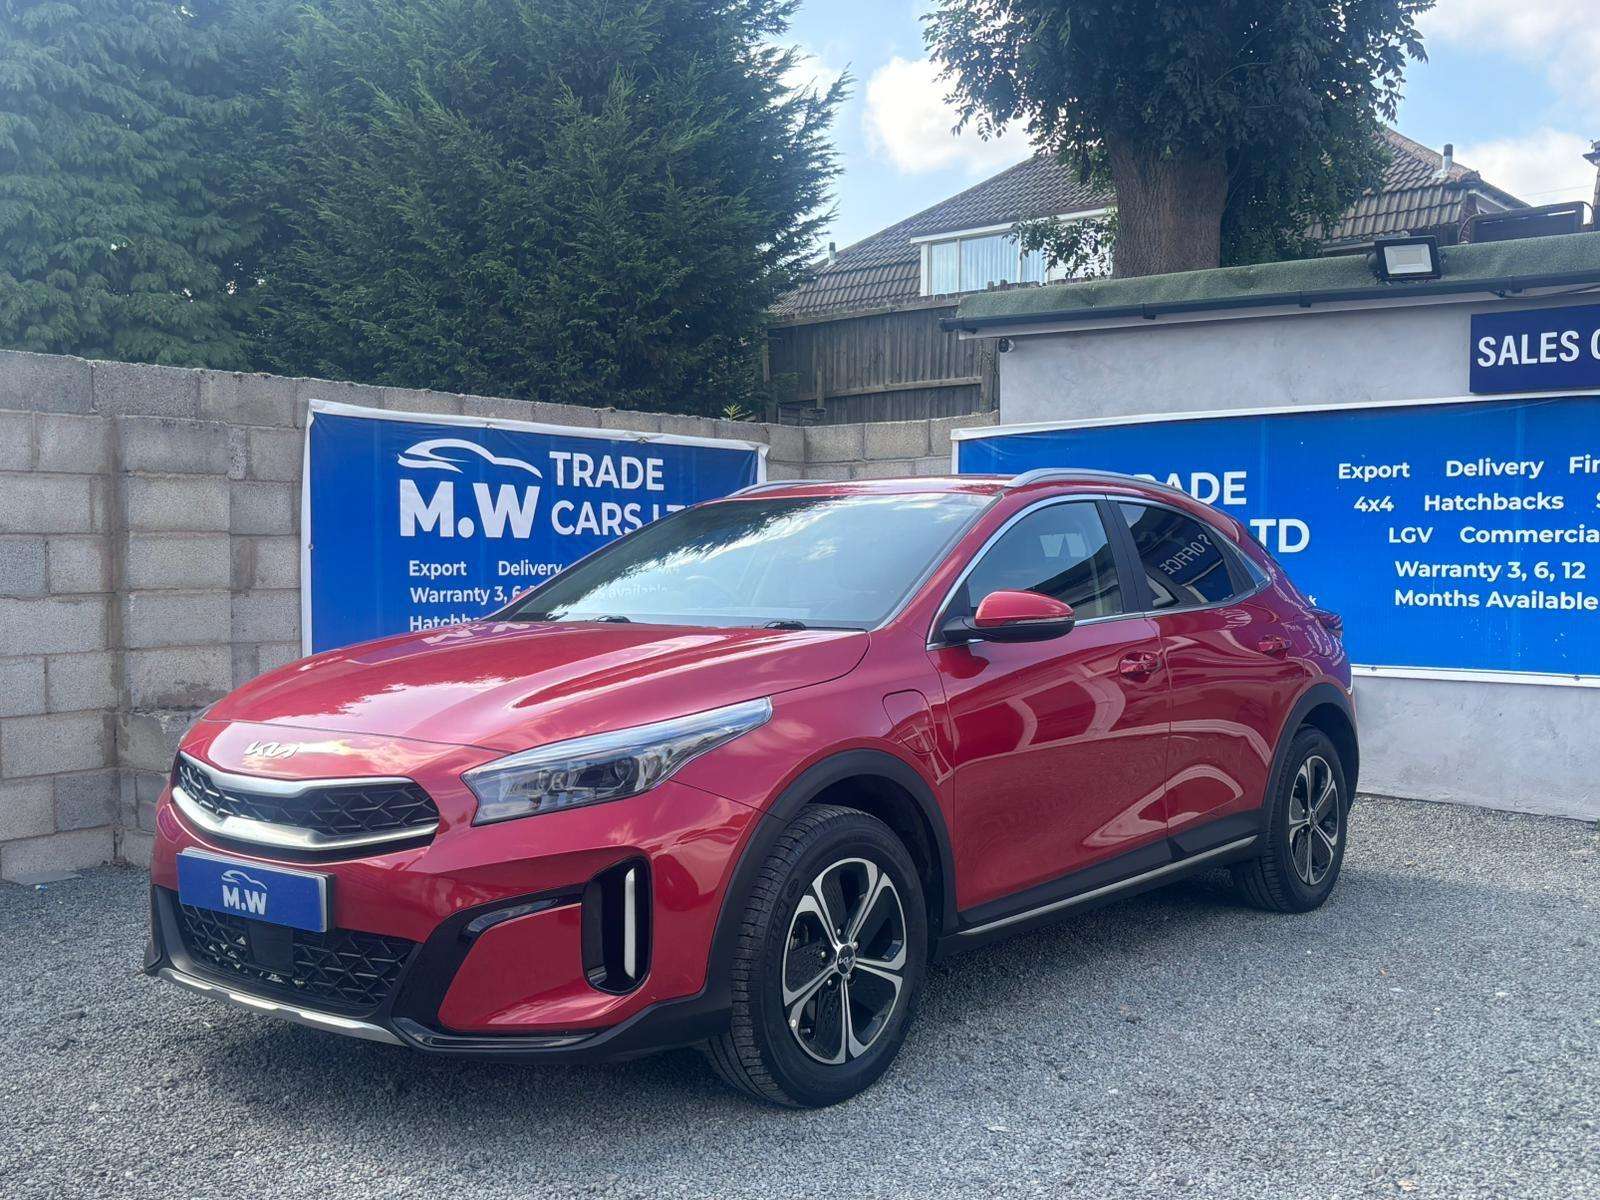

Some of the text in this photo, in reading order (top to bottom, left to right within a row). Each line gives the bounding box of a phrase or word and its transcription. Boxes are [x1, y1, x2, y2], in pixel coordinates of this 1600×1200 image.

[1477, 330, 1580, 367] SALES
[549, 451, 664, 491] TRADE
[1338, 462, 1410, 482] Export
[1446, 457, 1544, 479] Delivery
[399, 479, 541, 539] M.W
[1353, 492, 1564, 512] 4x4 Hatchbacks
[551, 500, 643, 536] CARS
[1388, 527, 1433, 543] LGV
[409, 557, 563, 580] Export Delivery
[1395, 560, 1586, 583] Warranty 3, 6, 12
[410, 586, 490, 606] Warranty
[494, 585, 508, 605] 3,
[1395, 589, 1599, 611] Months Available
[222, 885, 267, 915] M.W
